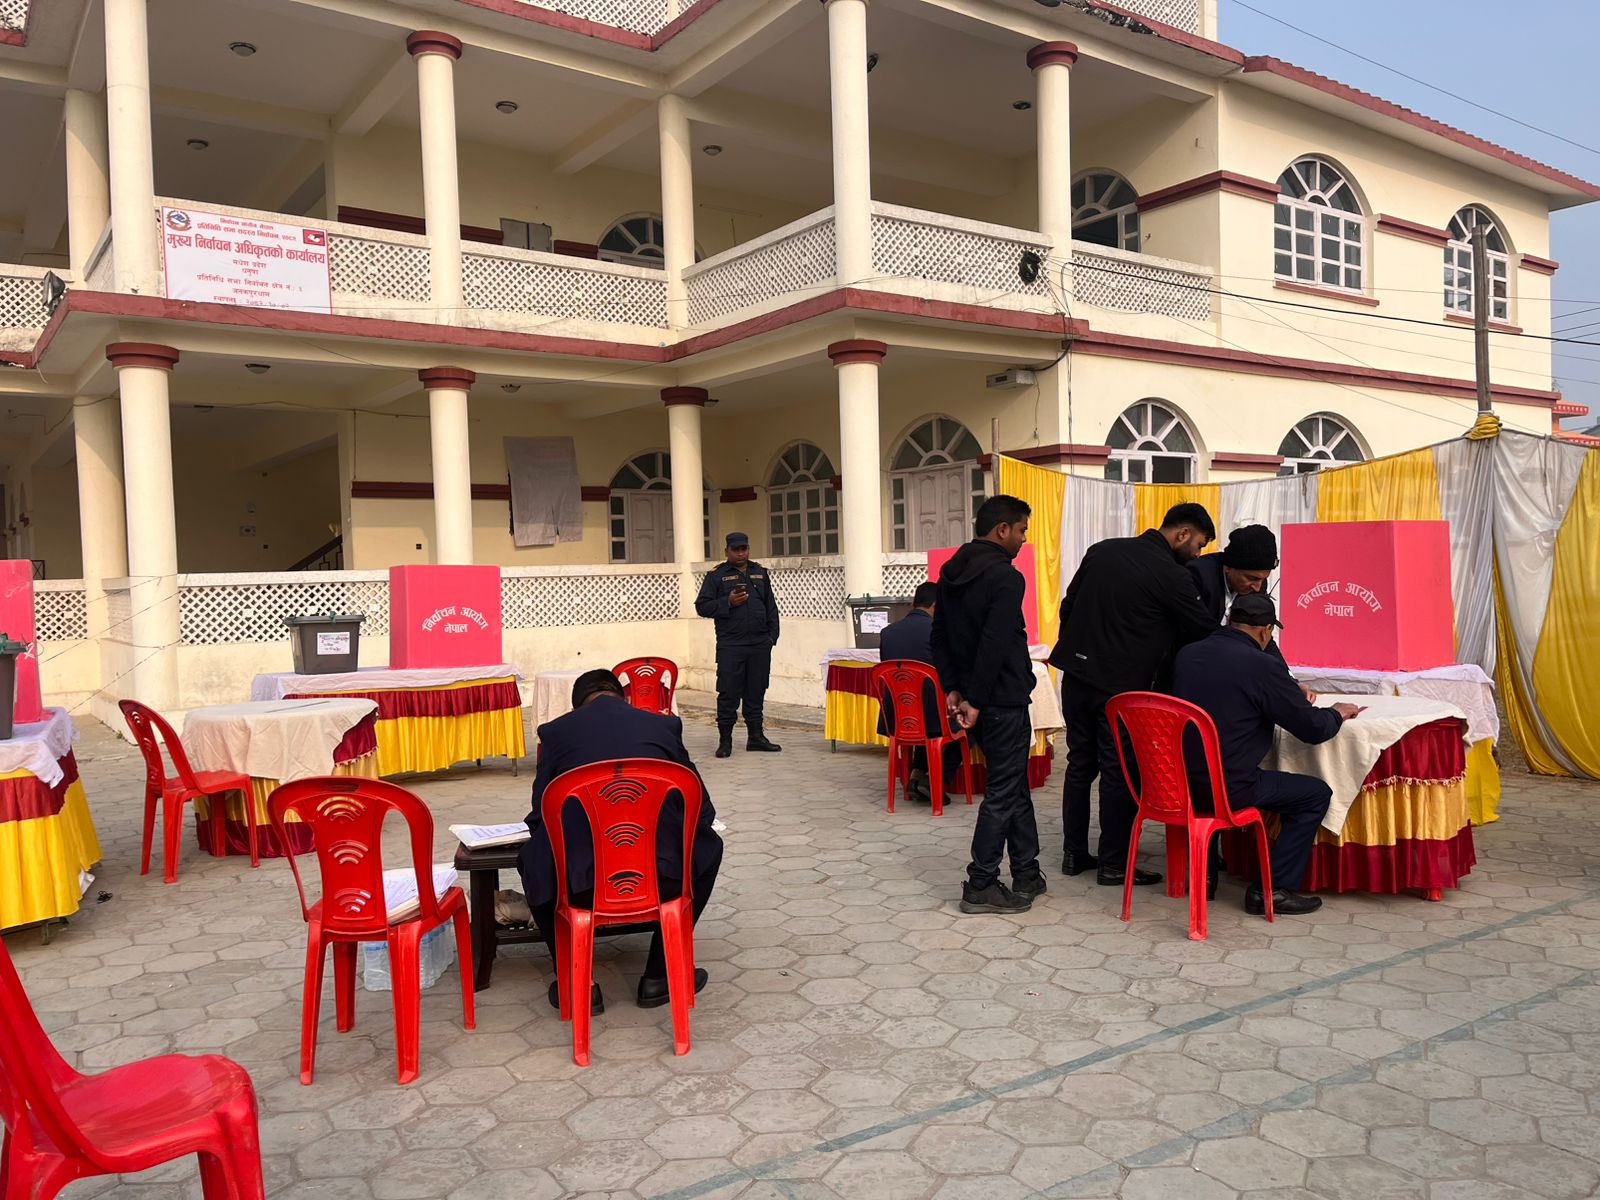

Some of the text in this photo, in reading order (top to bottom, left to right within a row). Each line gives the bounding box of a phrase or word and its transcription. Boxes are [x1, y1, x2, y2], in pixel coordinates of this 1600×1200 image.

[167, 233, 325, 264] मुख्य निर्वाचन अधिकृतको कार्यालय
[252, 261, 267, 269] प्रदेश
[197, 273, 224, 283] प्रतिनिधि
[227, 277, 241, 285] सभा
[245, 278, 269, 288] निर्वाचन
[1297, 580, 1382, 613] निर्वाचन आयोग
[1324, 603, 1354, 617] नेपाल
[422, 606, 489, 632] निर्वाचन आयोग
[444, 623, 468, 633] नेपाल
